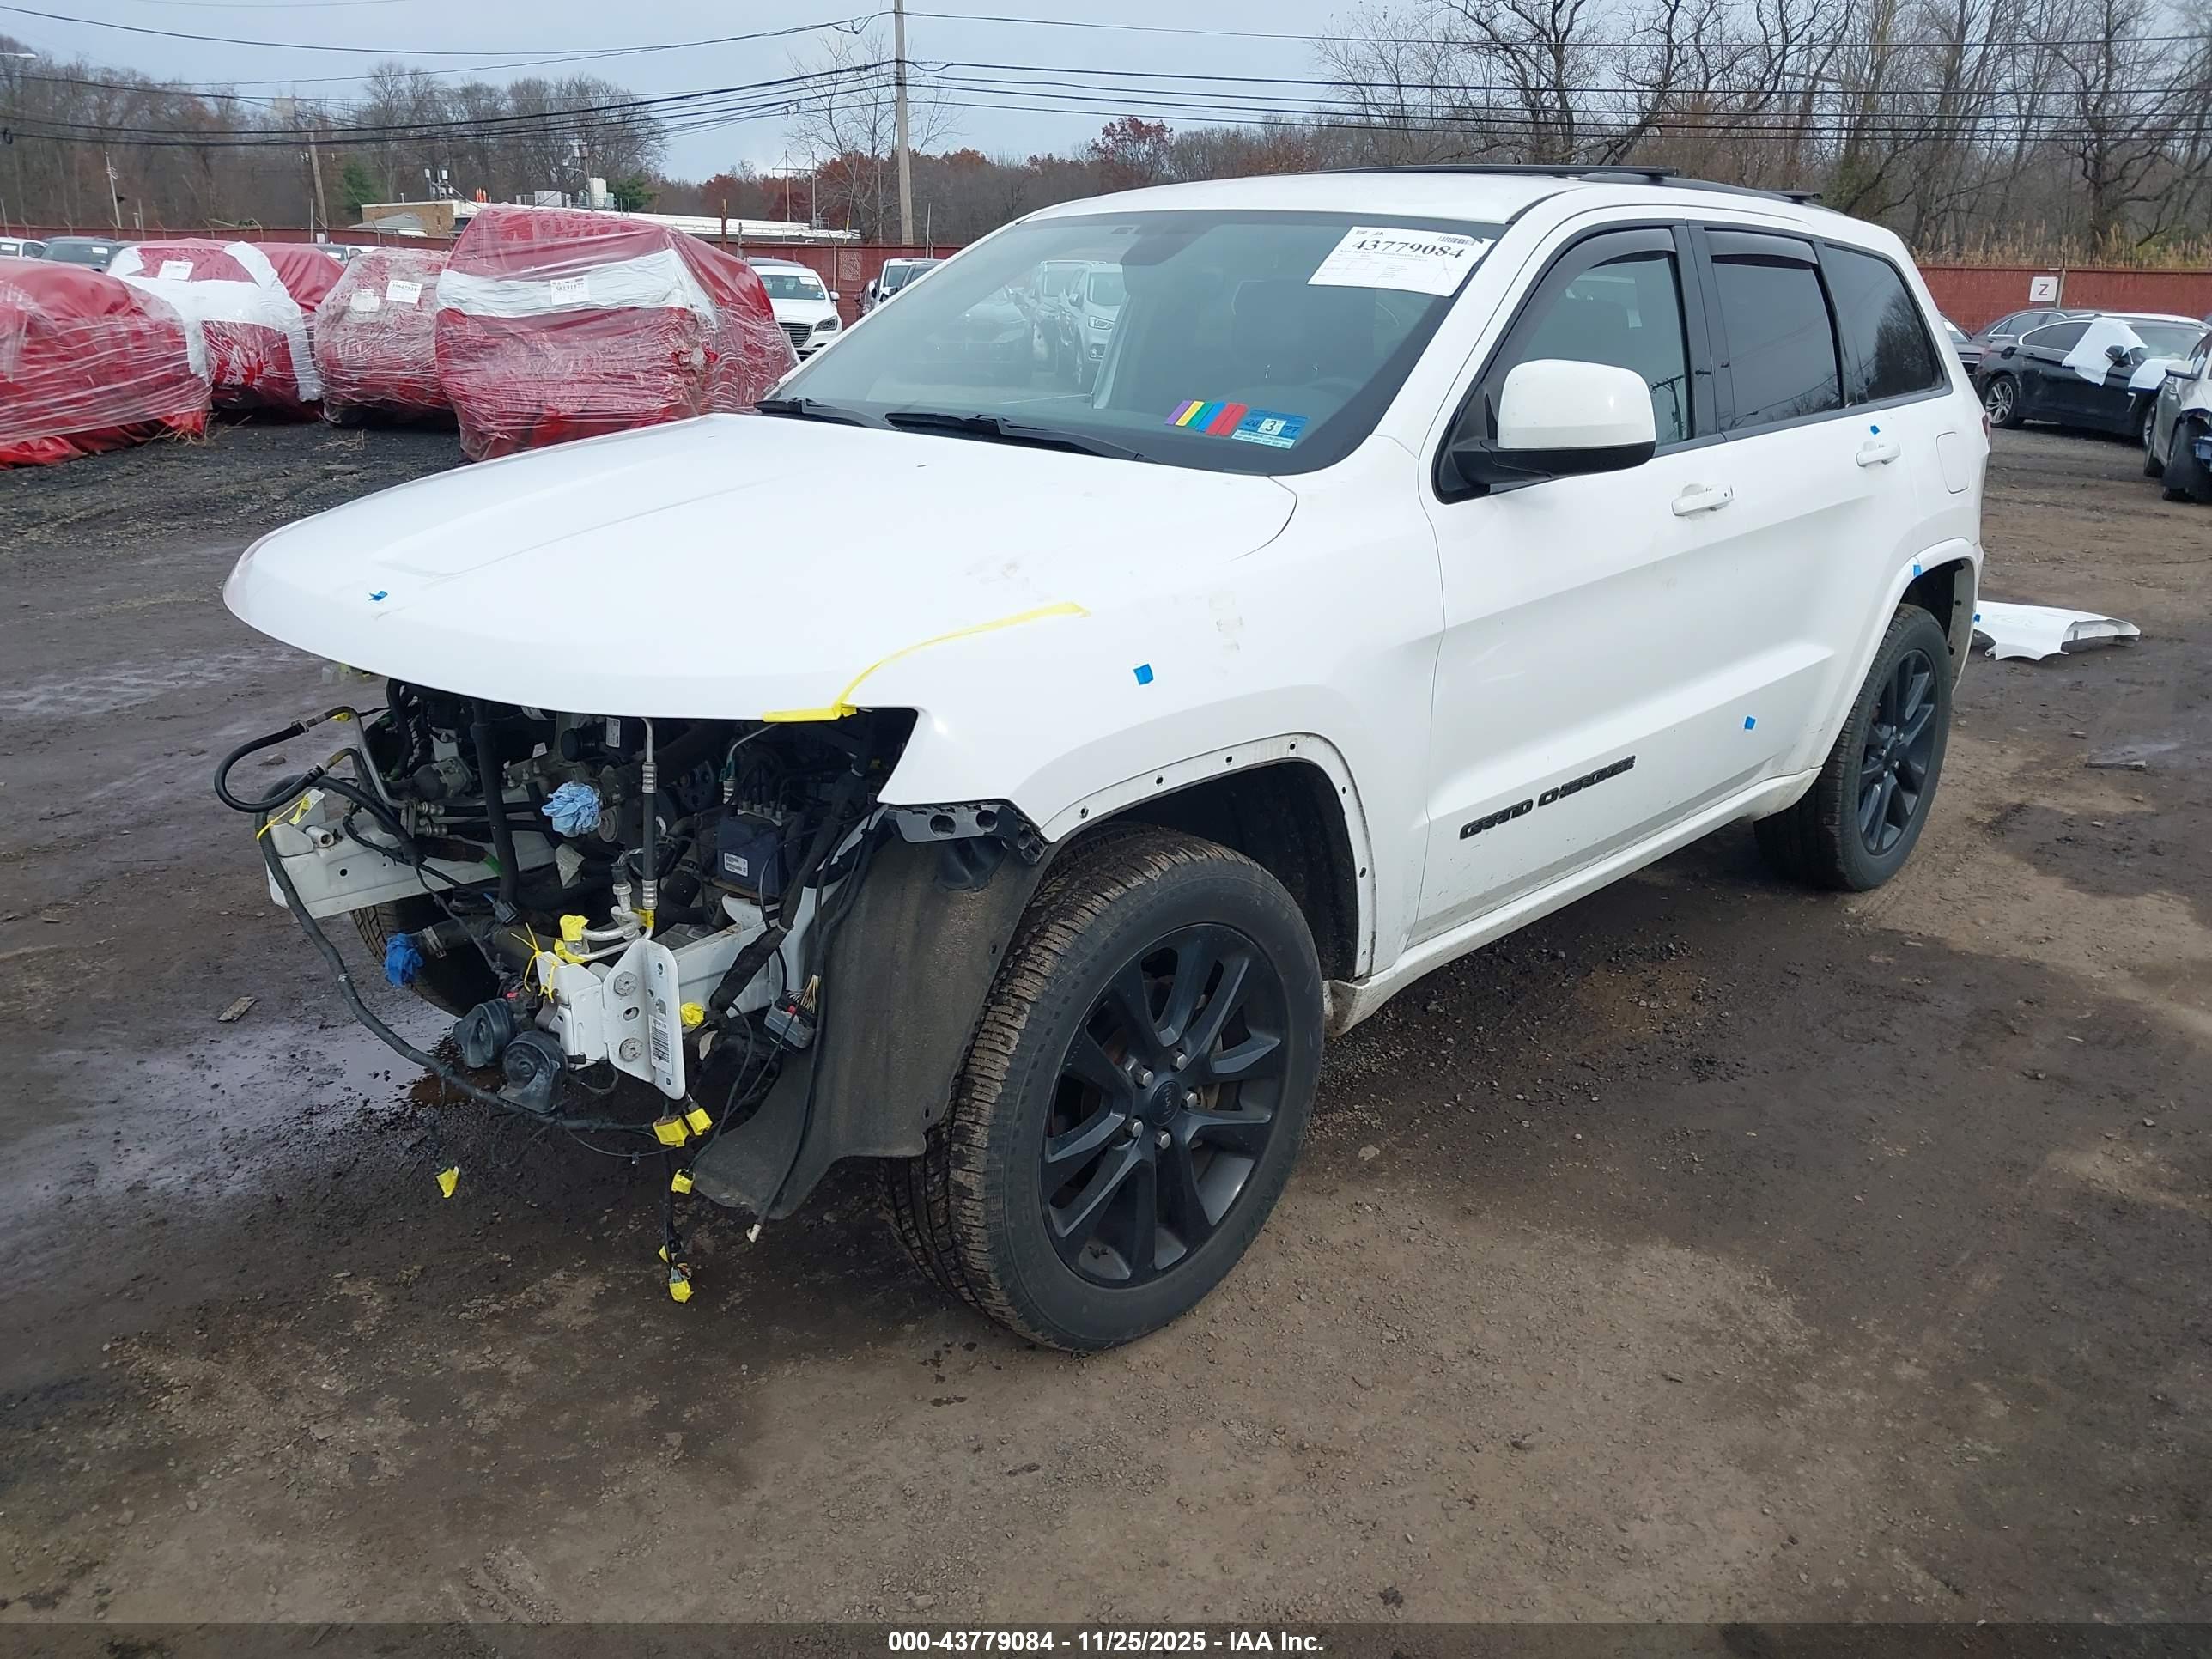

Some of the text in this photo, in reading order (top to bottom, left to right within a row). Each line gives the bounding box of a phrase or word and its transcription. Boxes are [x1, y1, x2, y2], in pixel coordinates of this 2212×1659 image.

[1353, 239, 1465, 258] 43779084
[2039, 283, 2049, 295] Z
[1266, 420, 1277, 431] 3
[1460, 755, 1636, 839] GRAND CHEROKEE
